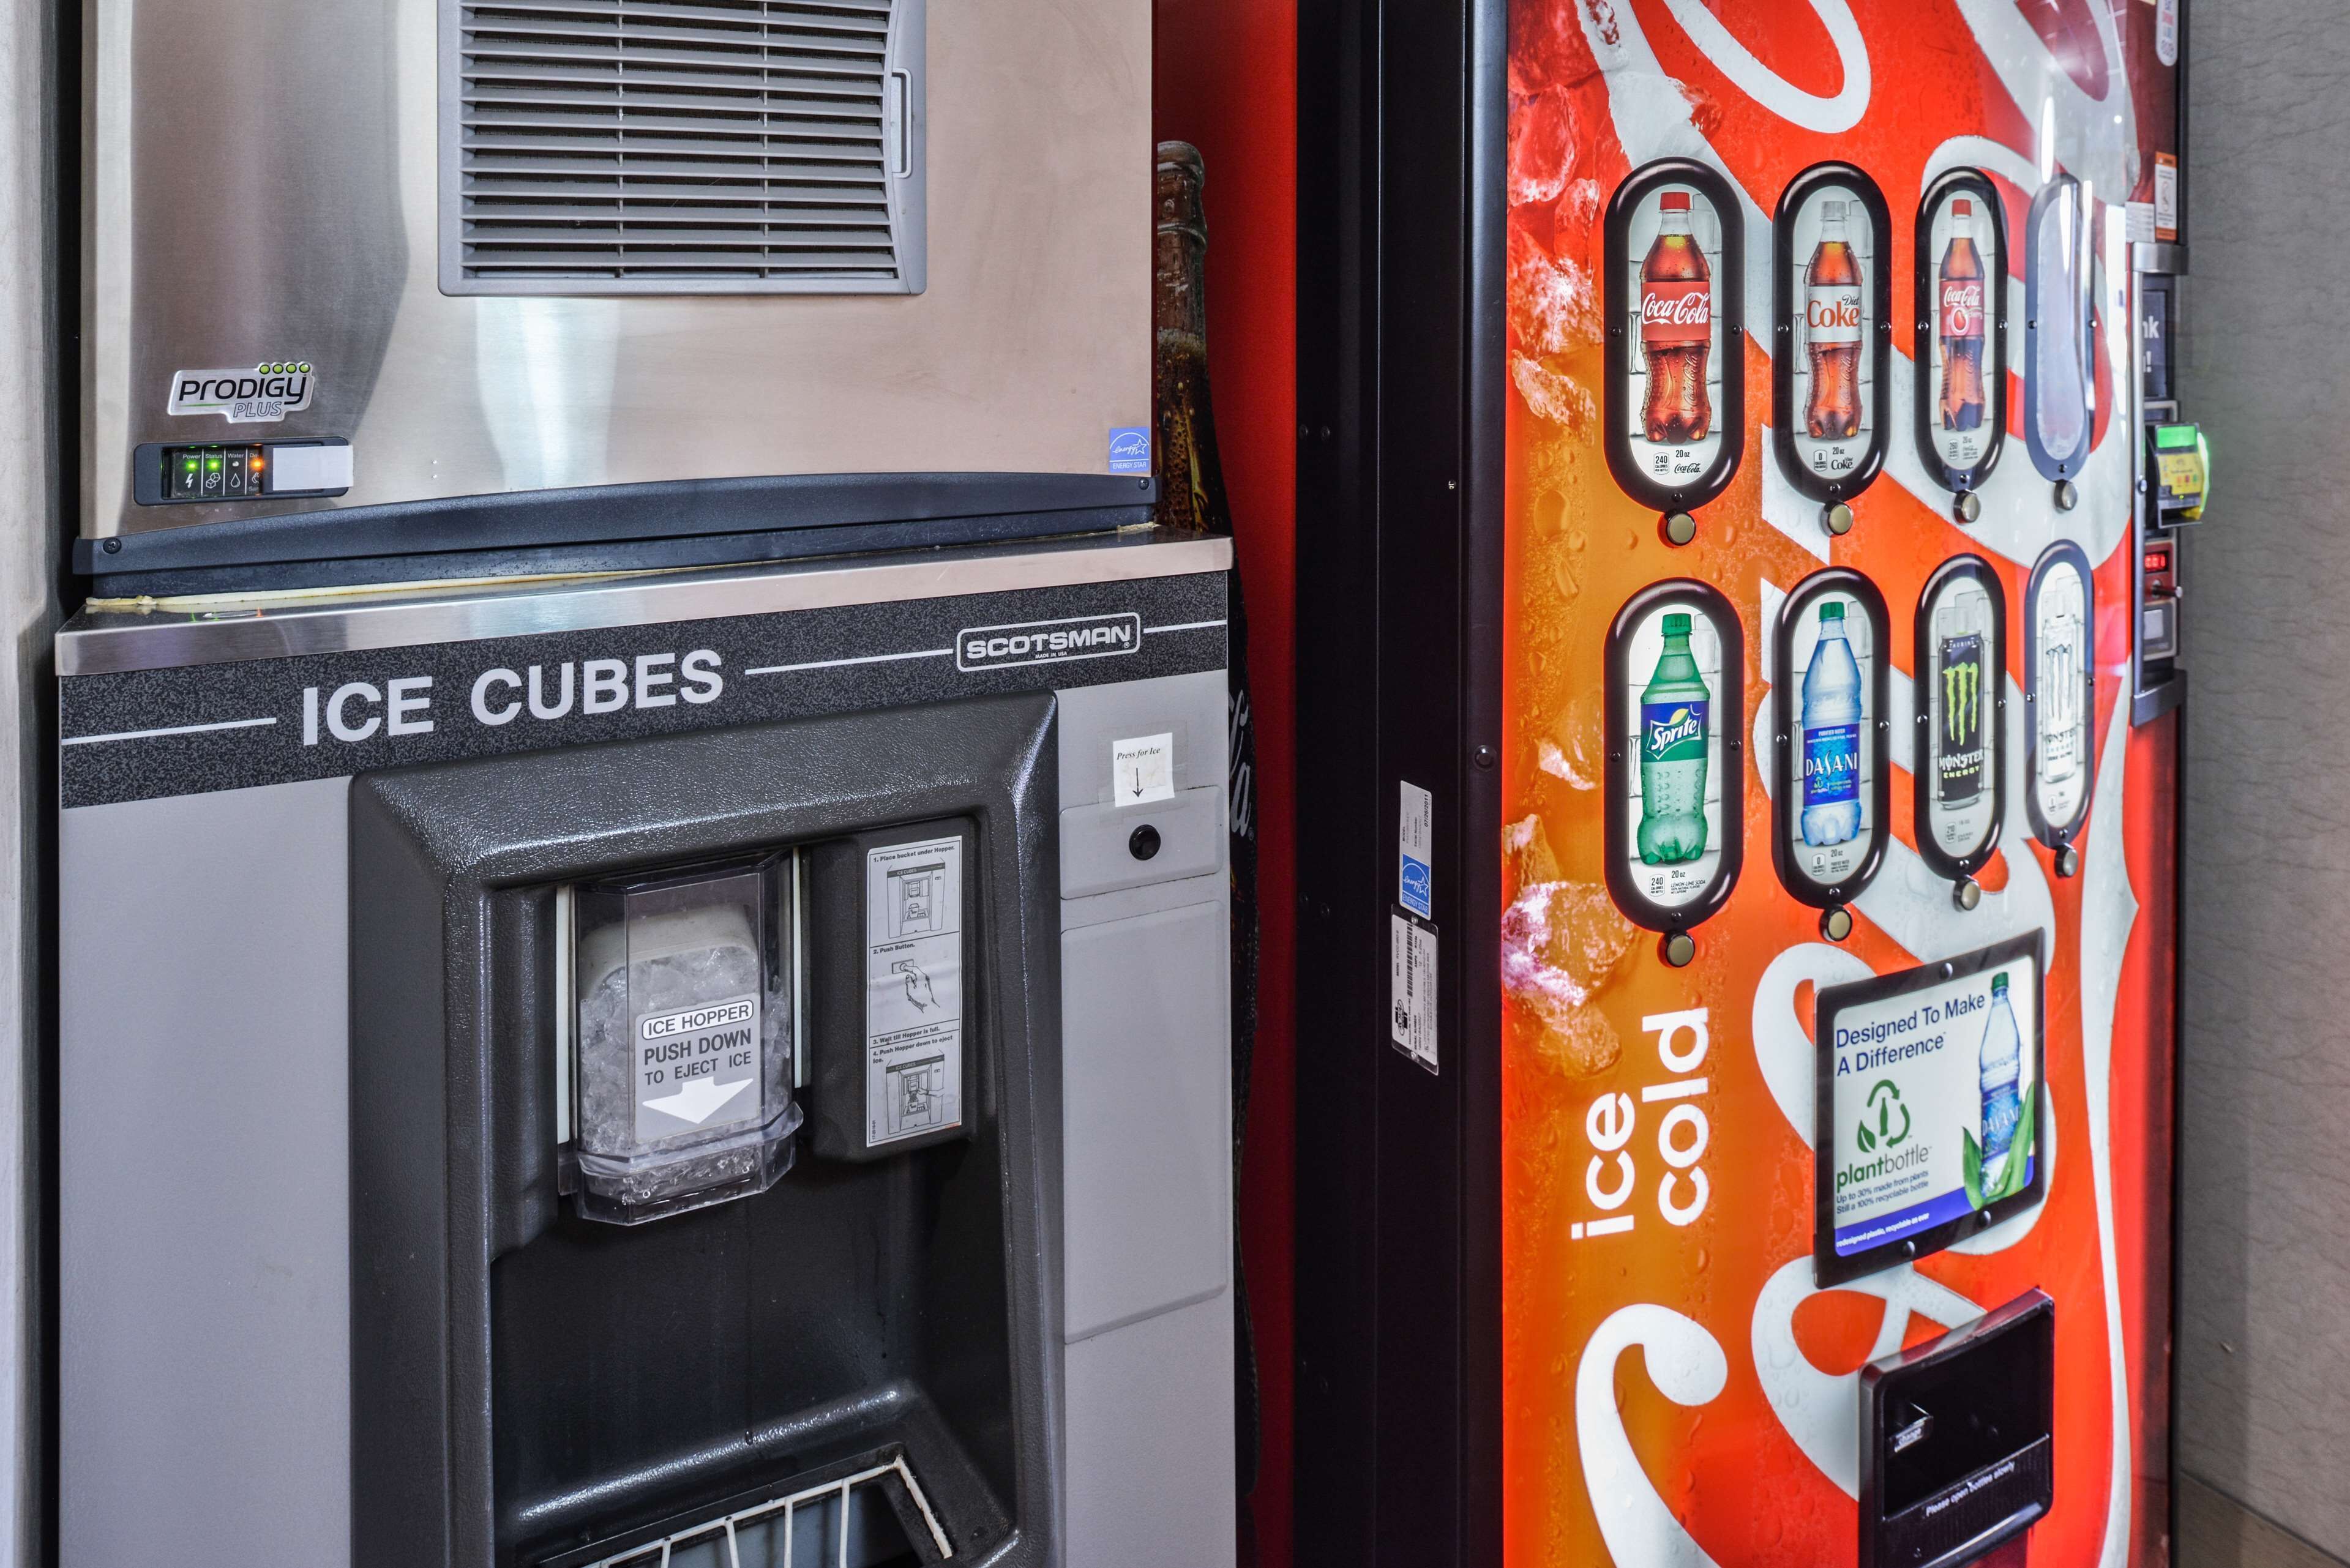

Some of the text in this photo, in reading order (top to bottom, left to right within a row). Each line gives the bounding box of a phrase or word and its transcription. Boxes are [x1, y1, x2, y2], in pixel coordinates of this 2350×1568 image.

[1642, 292, 1710, 325] Coca-Cola
[1807, 300, 1860, 328] Coke
[1842, 294, 1859, 305] Diet
[233, 401, 282, 417] PLUS
[1655, 455, 1667, 464] 240
[1832, 459, 1853, 470] Coke
[967, 625, 1131, 659] SCOTSMAN
[303, 649, 724, 746] ICE CUBES
[1652, 718, 1697, 750] Sprite
[1117, 747, 1161, 761] Press for Ice
[1806, 750, 1857, 779] DASANI
[1939, 749, 1983, 771] MONSTER
[1944, 766, 1980, 778] ENERGY
[897, 851, 916, 861] bucket
[934, 846, 955, 854] Hopper.
[1652, 877, 1663, 886] 240
[1671, 870, 1679, 879] 20
[1403, 894, 1428, 913] ENERGY STAR
[649, 1004, 749, 1036] ICE HOPPER
[1836, 992, 1985, 1048] Designed To Make
[645, 1028, 752, 1066] PUSH DOWN
[895, 1043, 915, 1053] Hopper
[939, 1035, 952, 1043] eject
[902, 1031, 922, 1039] Hopper
[645, 1051, 752, 1086] TO EJECT ICE
[1837, 1032, 1944, 1077] A Difference
[1641, 1006, 1709, 1226] cold
[1570, 1091, 1635, 1241] ice
[1836, 1143, 1929, 1193] plantbottle
[1836, 1195, 1847, 1204] Up
[1857, 1189, 1872, 1198] 30%
[1873, 1182, 1892, 1193] made
[1894, 1178, 1909, 1186] from
[1910, 1170, 1928, 1182] plants
[1836, 1204, 1850, 1214] Still
[1857, 1197, 1874, 1208] 100%
[1876, 1187, 1909, 1203] recyclable
[1910, 1181, 1928, 1192] bottle
[1836, 1233, 1866, 1247] redesigned
[1926, 1462, 2015, 1517] Please open bottles slowly
